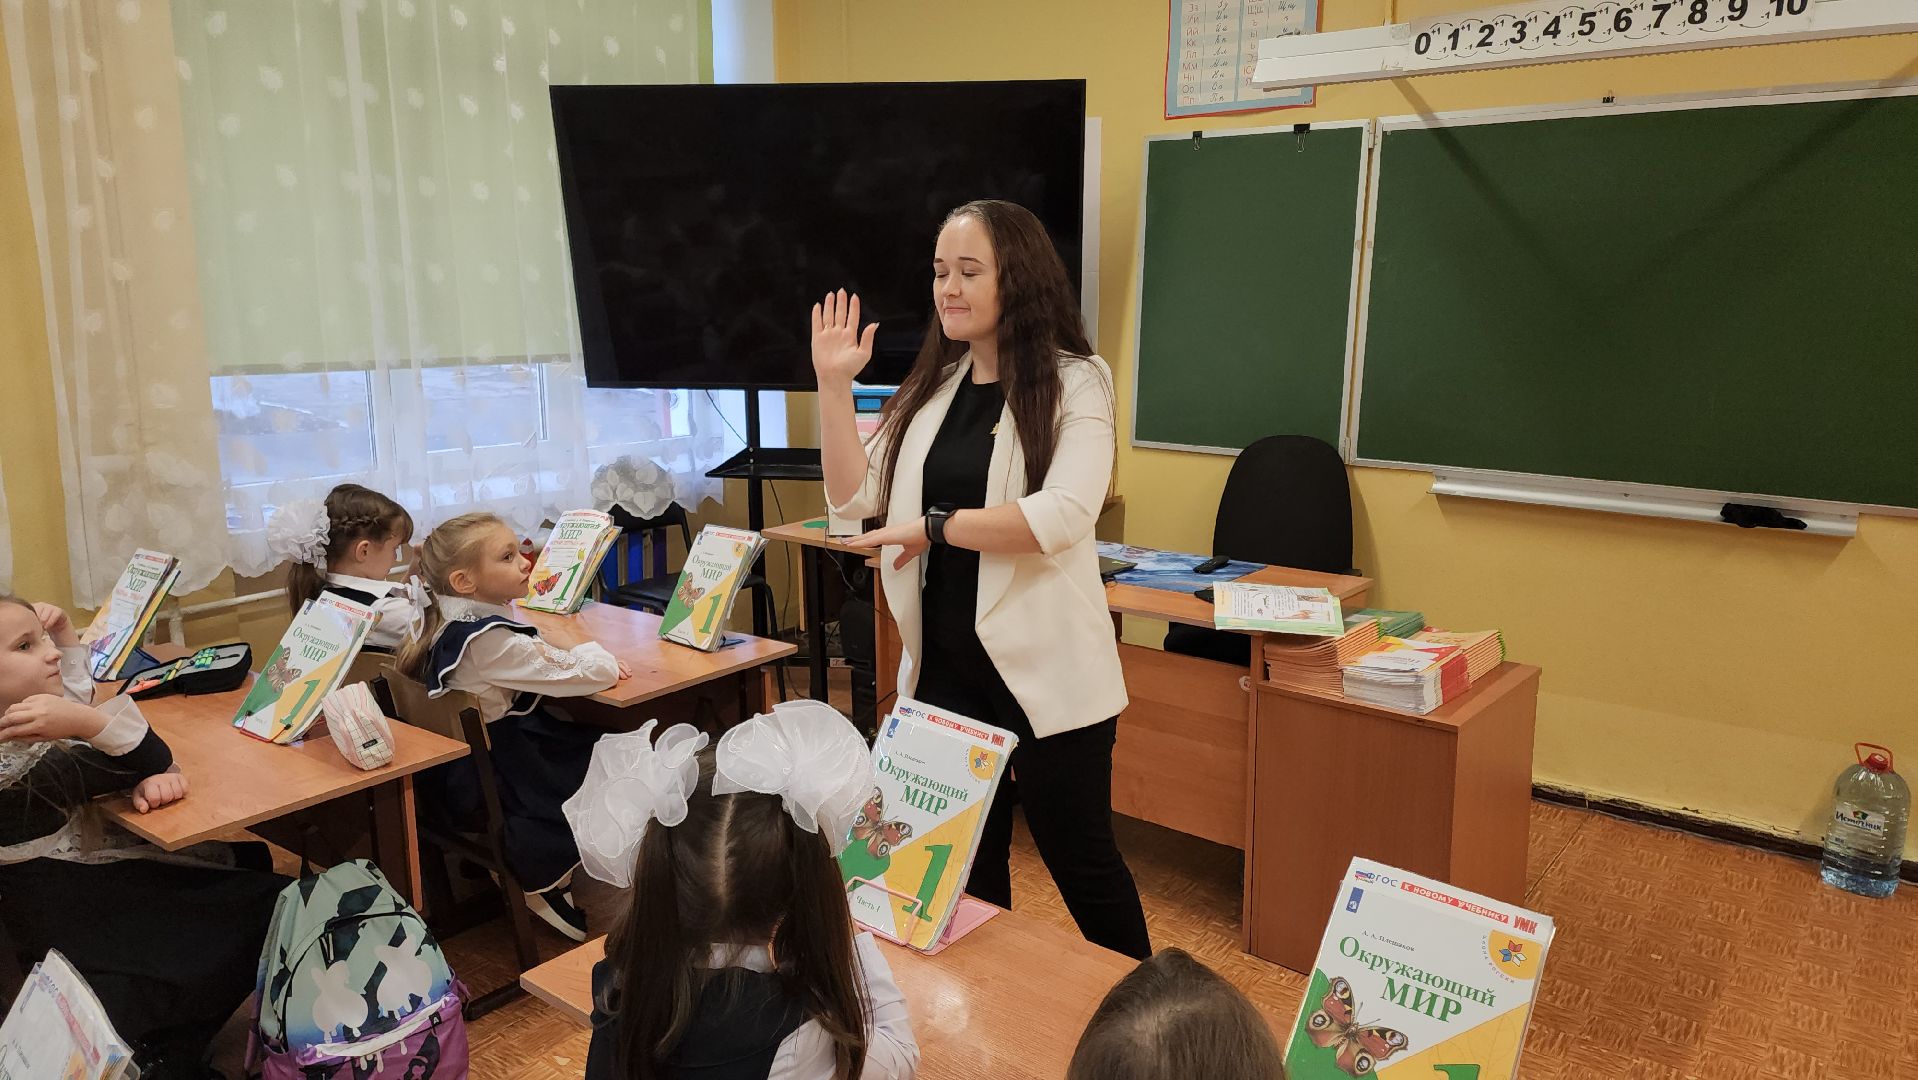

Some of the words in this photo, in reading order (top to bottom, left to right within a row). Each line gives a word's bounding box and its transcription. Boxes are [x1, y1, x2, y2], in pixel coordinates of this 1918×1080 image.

[1414, 32, 1431, 55] 0
[1447, 28, 1460, 51] 1
[1476, 24, 1495, 48] 2
[1510, 20, 1527, 44] 3
[1543, 15, 1561, 40] 4
[1577, 11, 1596, 36] 5
[1613, 7, 1633, 32] 6
[1651, 3, 1671, 29] 7
[1688, 0, 1708, 25] 8
[1727, 0, 1748, 21] 9
[1769, 0, 1808, 17] 10
[552, 562, 582, 601] 1
[698, 593, 722, 634] 1
[293, 627, 340, 651] Окружающий
[299, 644, 327, 663] МИР
[280, 679, 321, 726] 1
[878, 754, 969, 802] Окружающий
[900, 784, 948, 816] МИР
[902, 843, 953, 922] 1
[1367, 872, 1398, 888] ФГОС
[1404, 883, 1412, 891] К
[1413, 886, 1454, 904] НОВОМУ
[1458, 899, 1507, 923] УЧЕБНИКУ
[1513, 915, 1538, 936] УМК
[1339, 936, 1497, 1008] Окружающий
[1379, 977, 1463, 1023] МИР
